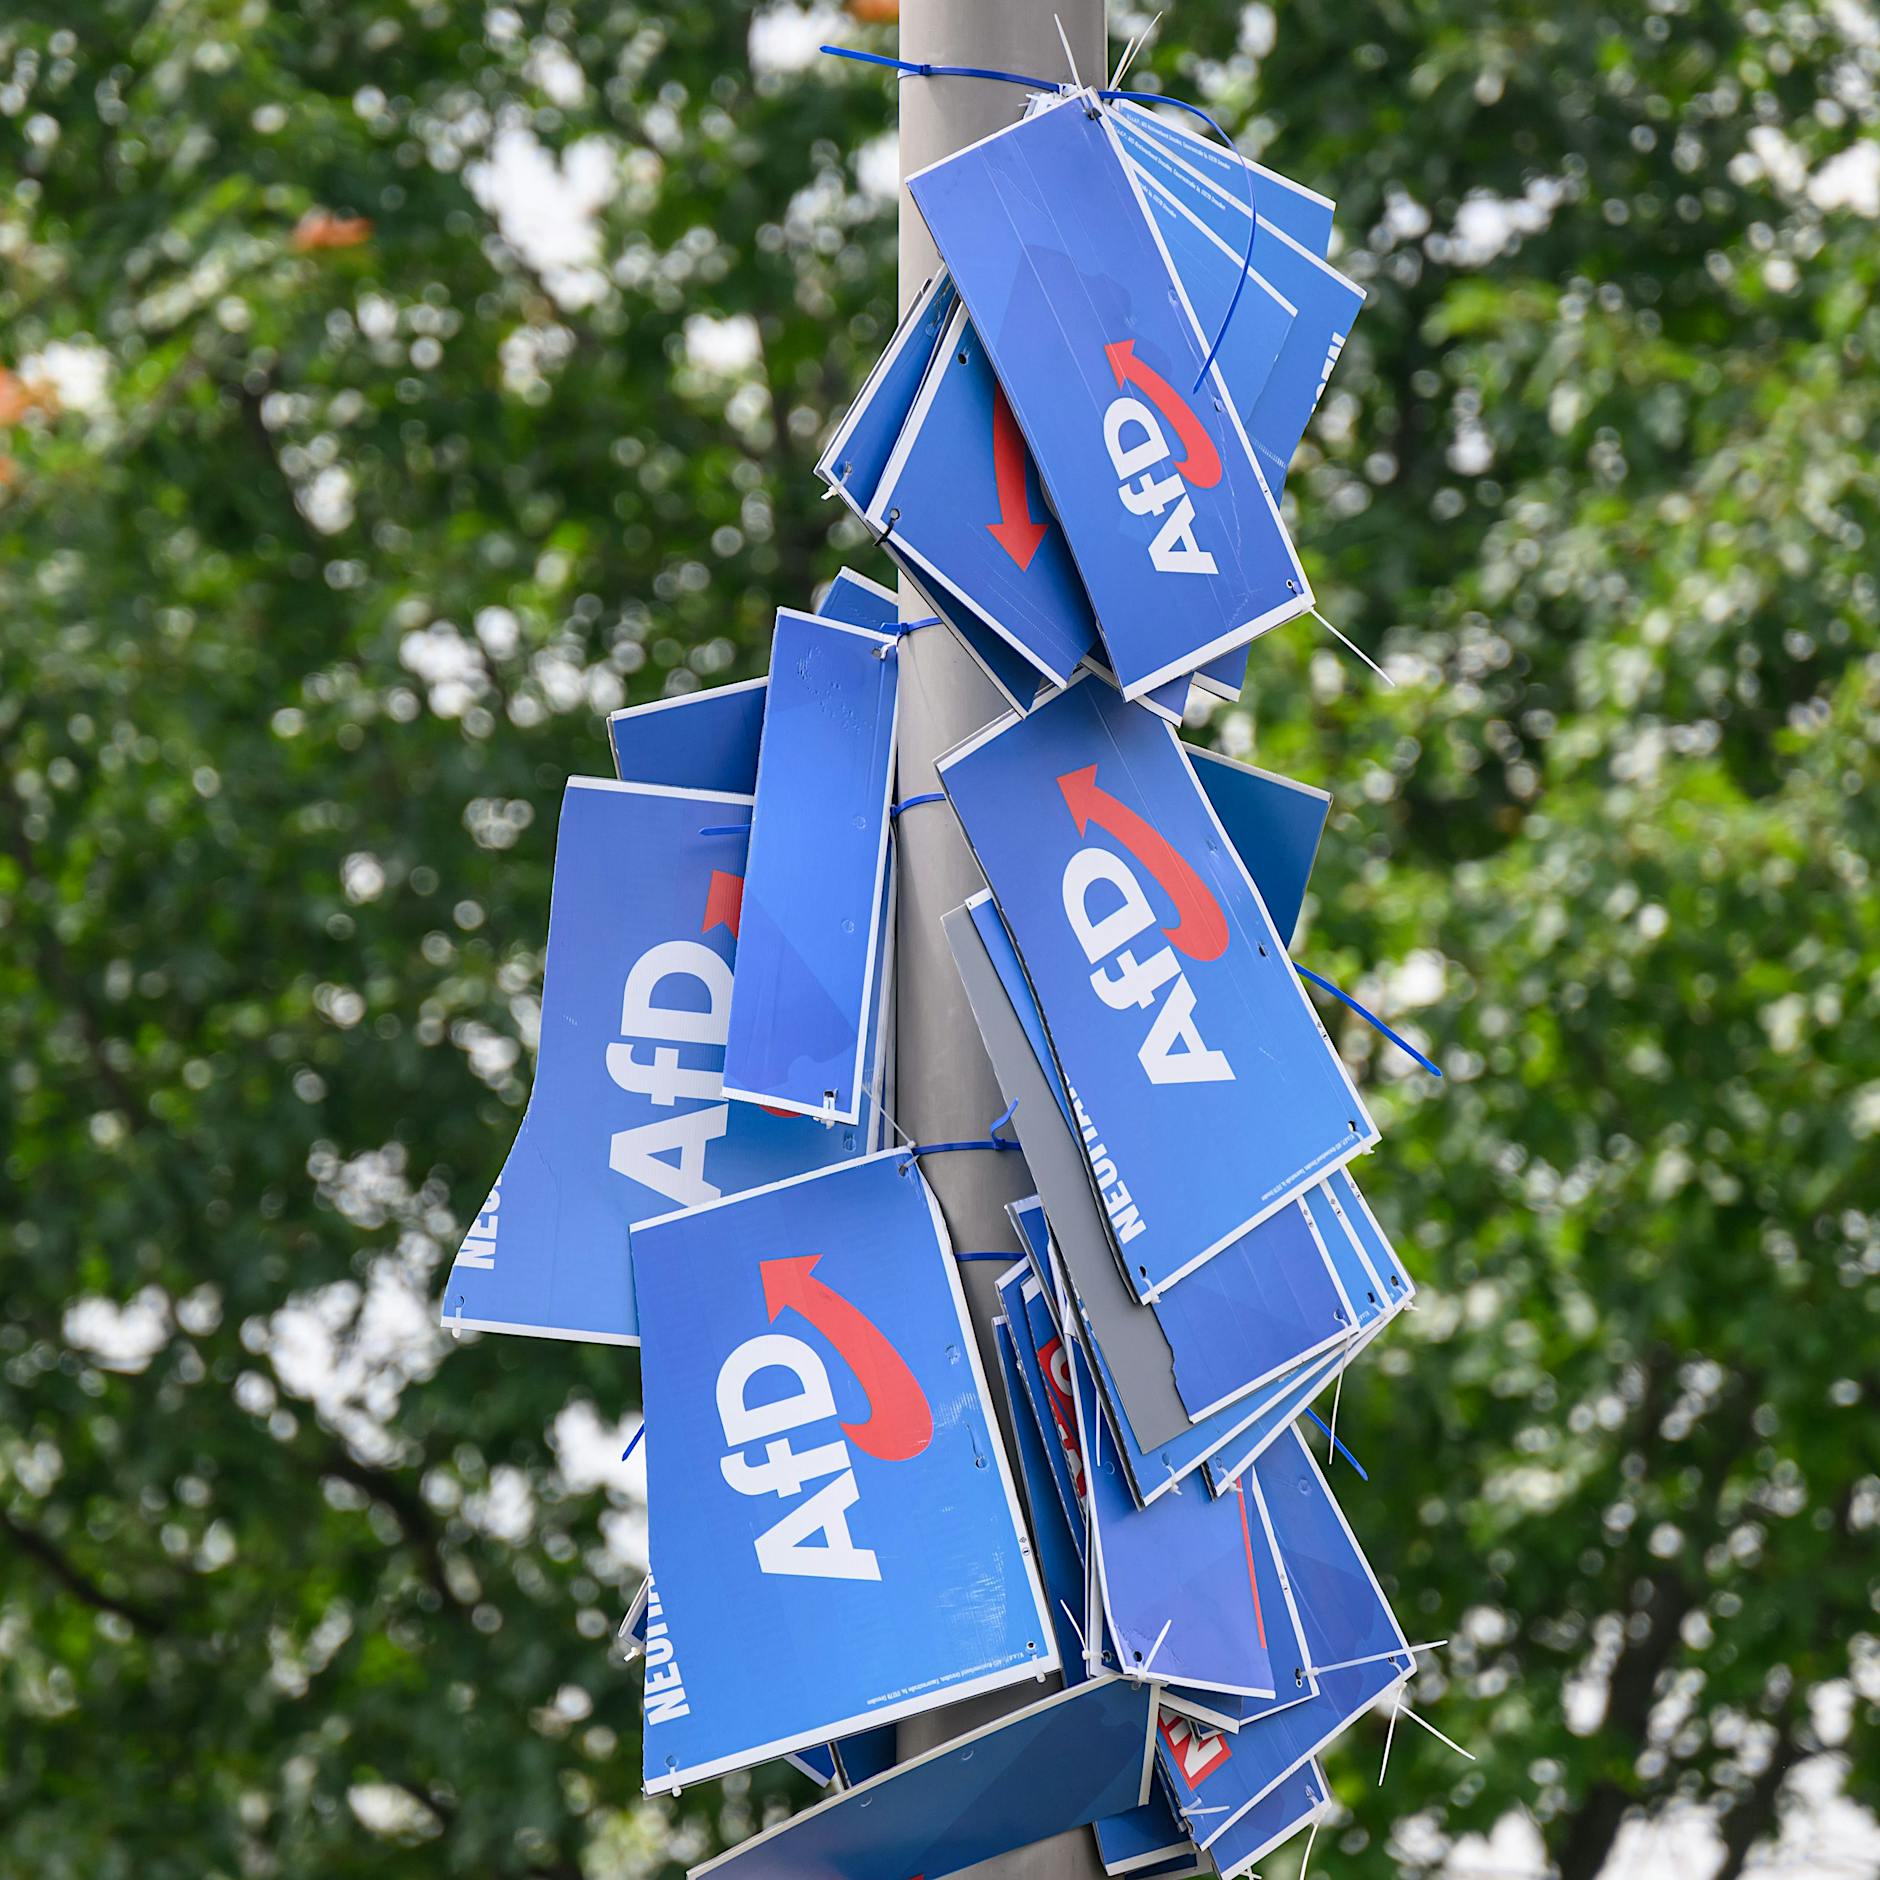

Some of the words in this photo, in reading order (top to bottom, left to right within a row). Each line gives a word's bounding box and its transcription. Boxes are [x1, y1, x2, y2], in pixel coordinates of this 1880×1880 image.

[1104, 398, 1218, 574] AfD
[606, 941, 734, 1206] AfD
[1063, 849, 1235, 1084] AfD
[717, 1335, 881, 1580] AfD
